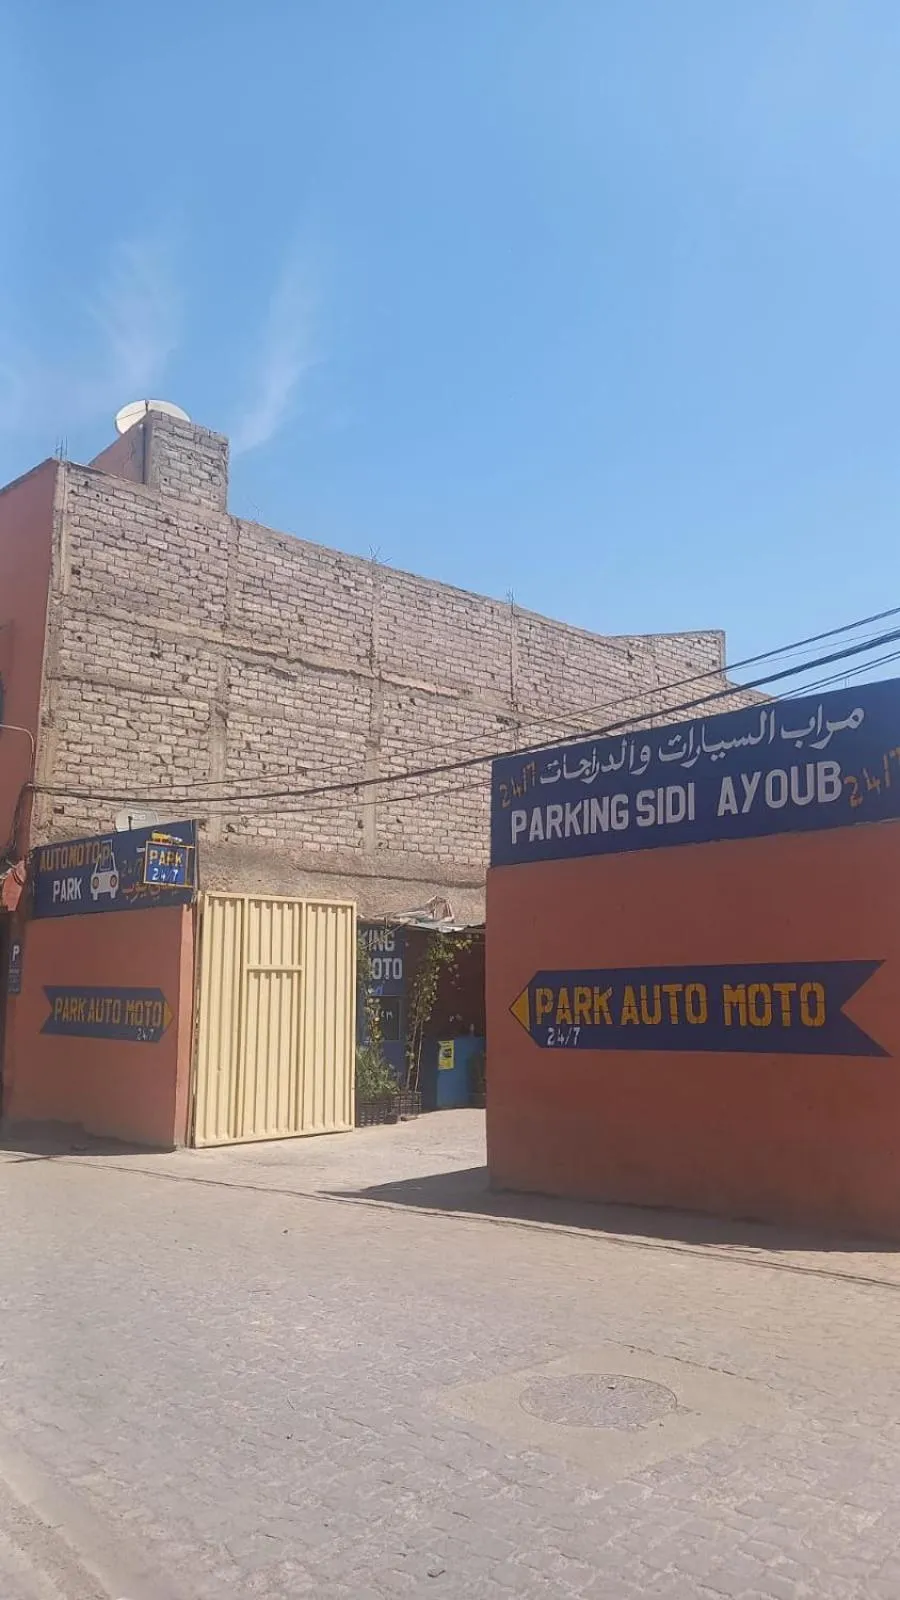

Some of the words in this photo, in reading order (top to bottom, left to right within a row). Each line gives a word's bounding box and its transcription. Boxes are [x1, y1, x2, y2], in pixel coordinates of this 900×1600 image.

[658, 709, 775, 769] السيارات
[511, 793, 629, 845] PARKING
[636, 782, 696, 828] SIDI
[717, 760, 843, 817] AYOUB
[149, 849, 183, 867] PARK
[152, 867, 179, 881] 24/7
[52, 877, 82, 903] PARK
[12, 945, 20, 961] P
[368, 957, 403, 980] OTO
[54, 997, 87, 1023] PARK
[88, 998, 121, 1025] AUTO
[124, 1000, 162, 1027] MOTO
[535, 986, 613, 1026] PARK
[620, 983, 709, 1027] AUTO
[722, 981, 827, 1028] MOTO
[546, 1026, 581, 1047] 24/7
